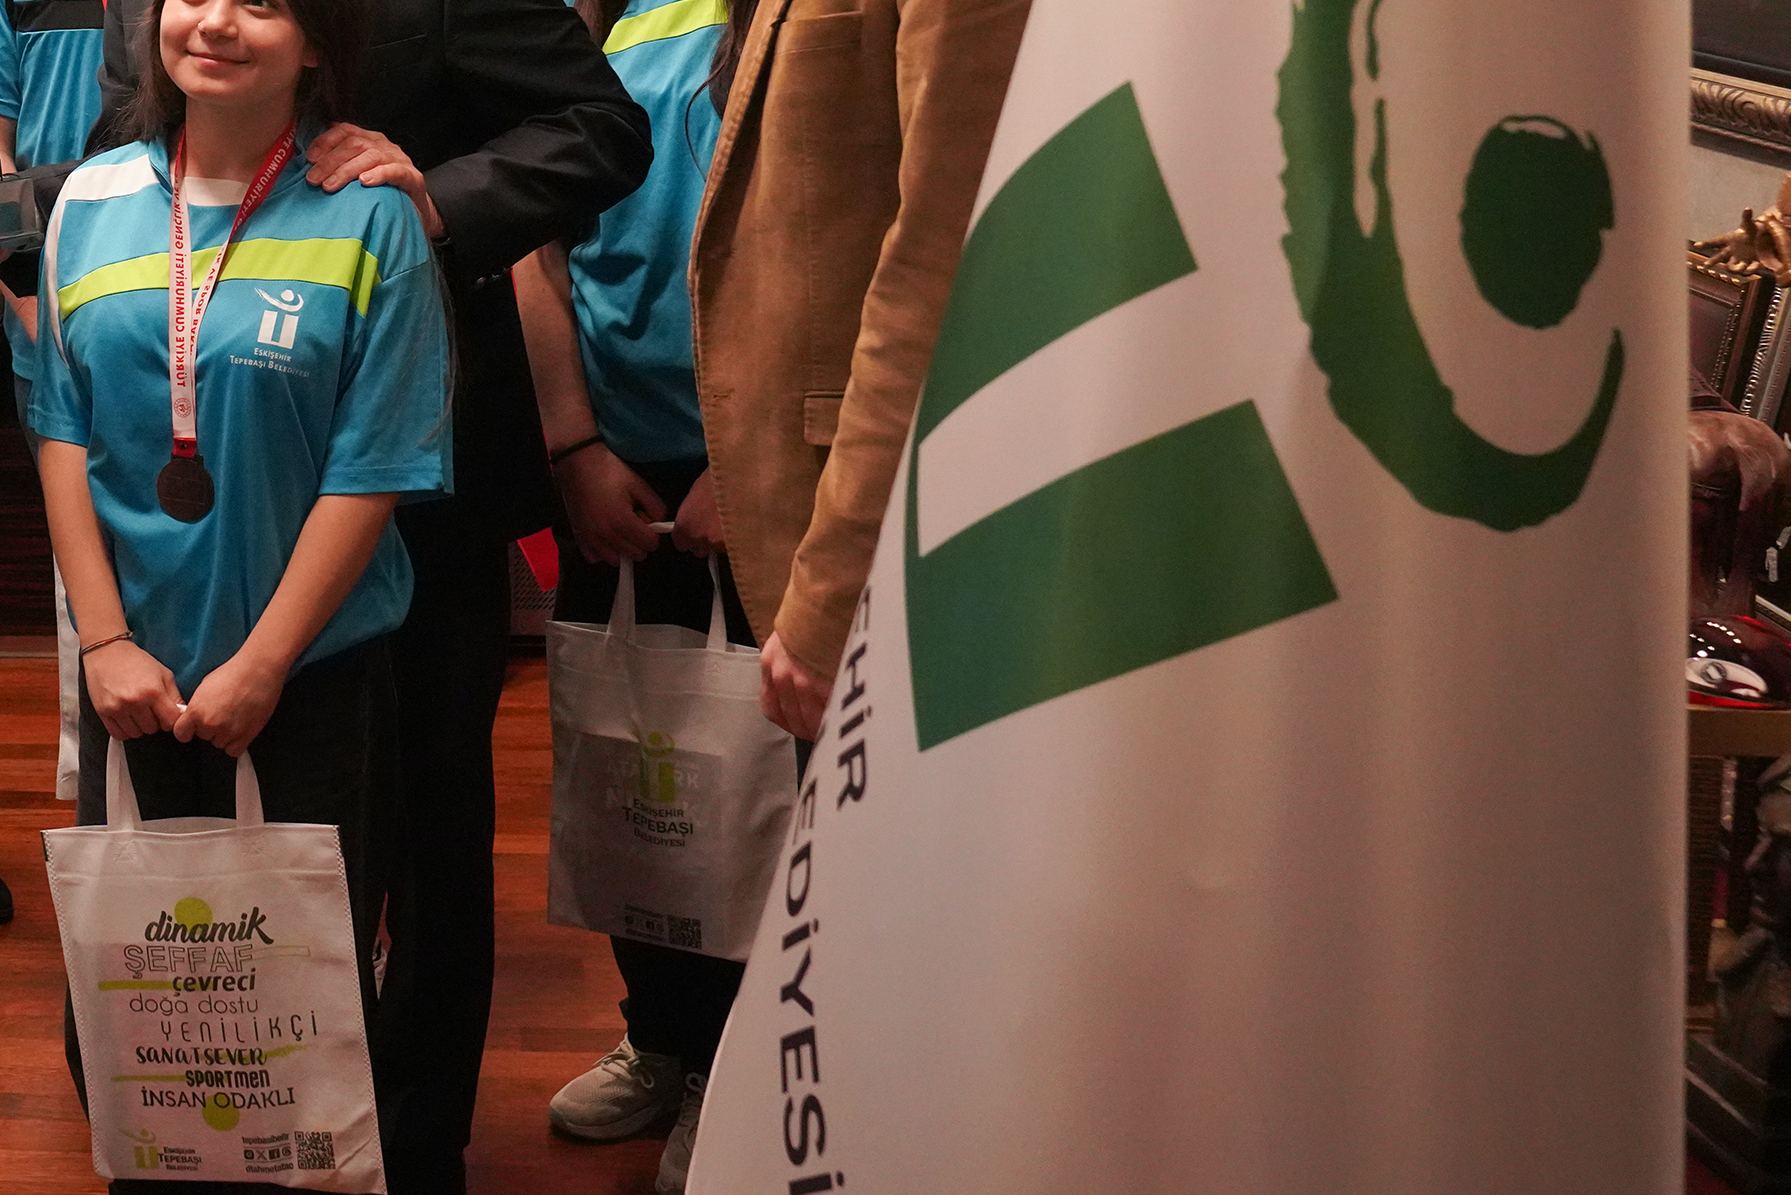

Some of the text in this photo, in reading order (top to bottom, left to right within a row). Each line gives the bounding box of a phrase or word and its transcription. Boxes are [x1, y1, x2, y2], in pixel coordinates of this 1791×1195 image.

[622, 807, 694, 837] TEPEBAŞI
[144, 906, 274, 945] dinamik
[124, 944, 254, 979] ŞEFFAF
[173, 968, 257, 997] çevreci
[780, 776, 845, 1195] EDİYESİ
[129, 993, 259, 1016] doğa dostu
[141, 1086, 296, 1110] İNSAN ODAKLI
[157, 1153, 202, 1164] TEPEBAŞI
